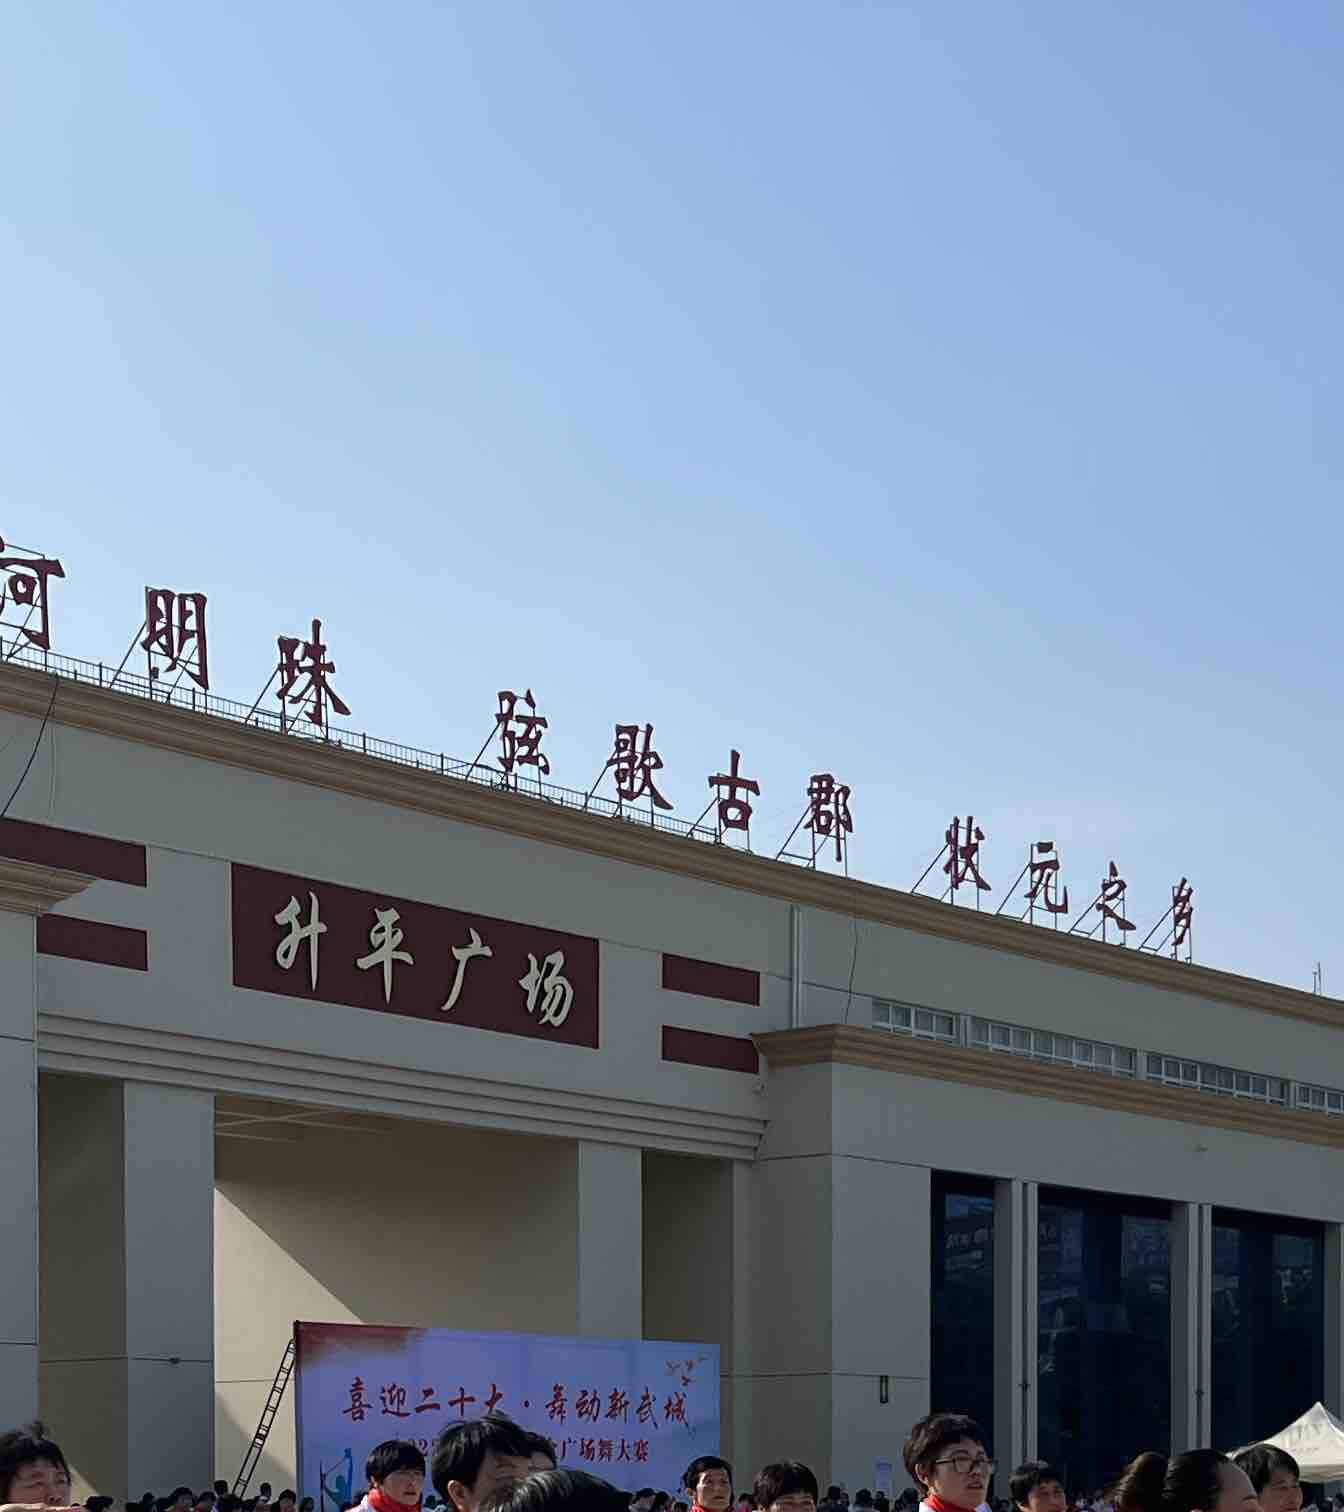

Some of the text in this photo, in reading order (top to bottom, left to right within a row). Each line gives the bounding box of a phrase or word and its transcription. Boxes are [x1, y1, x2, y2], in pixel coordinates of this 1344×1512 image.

[494, 687, 854, 862] 弦歌古郡
[943, 815, 1195, 947] 状元之乡
[274, 890, 574, 1028] 升平广场
[550, 1437, 649, 1462] 广场舞大赛
